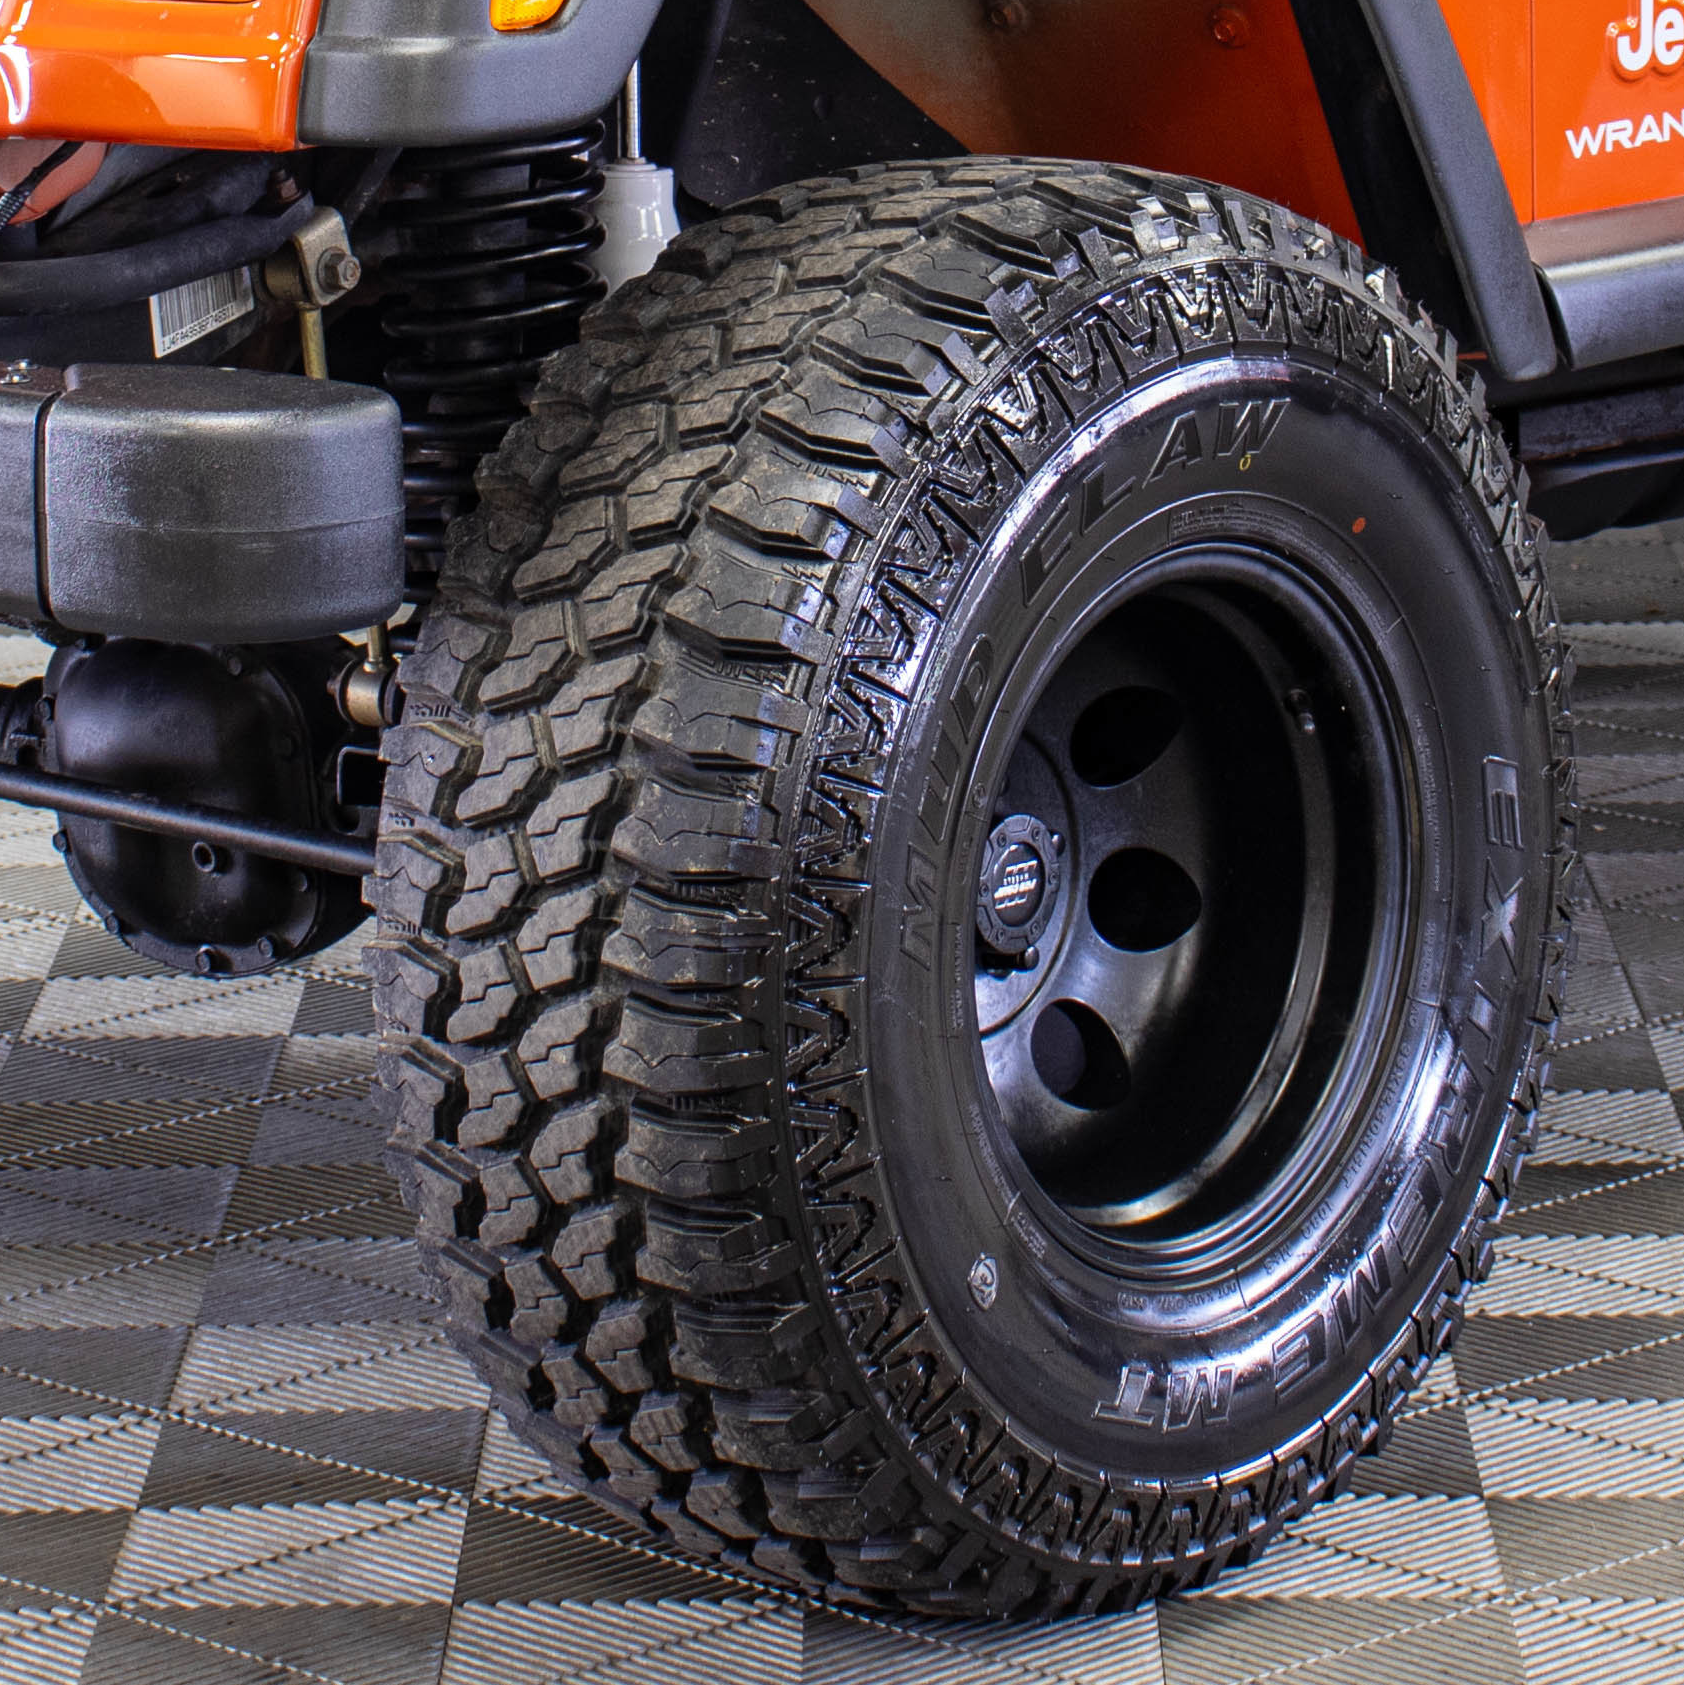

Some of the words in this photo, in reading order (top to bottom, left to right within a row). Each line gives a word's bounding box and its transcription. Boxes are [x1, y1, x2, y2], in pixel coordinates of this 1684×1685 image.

[900, 633, 994, 972] MUD
[1019, 396, 1292, 609] CLAW
[1272, 755, 1523, 1406] EXTREME
[1092, 1361, 1236, 1434] MT
